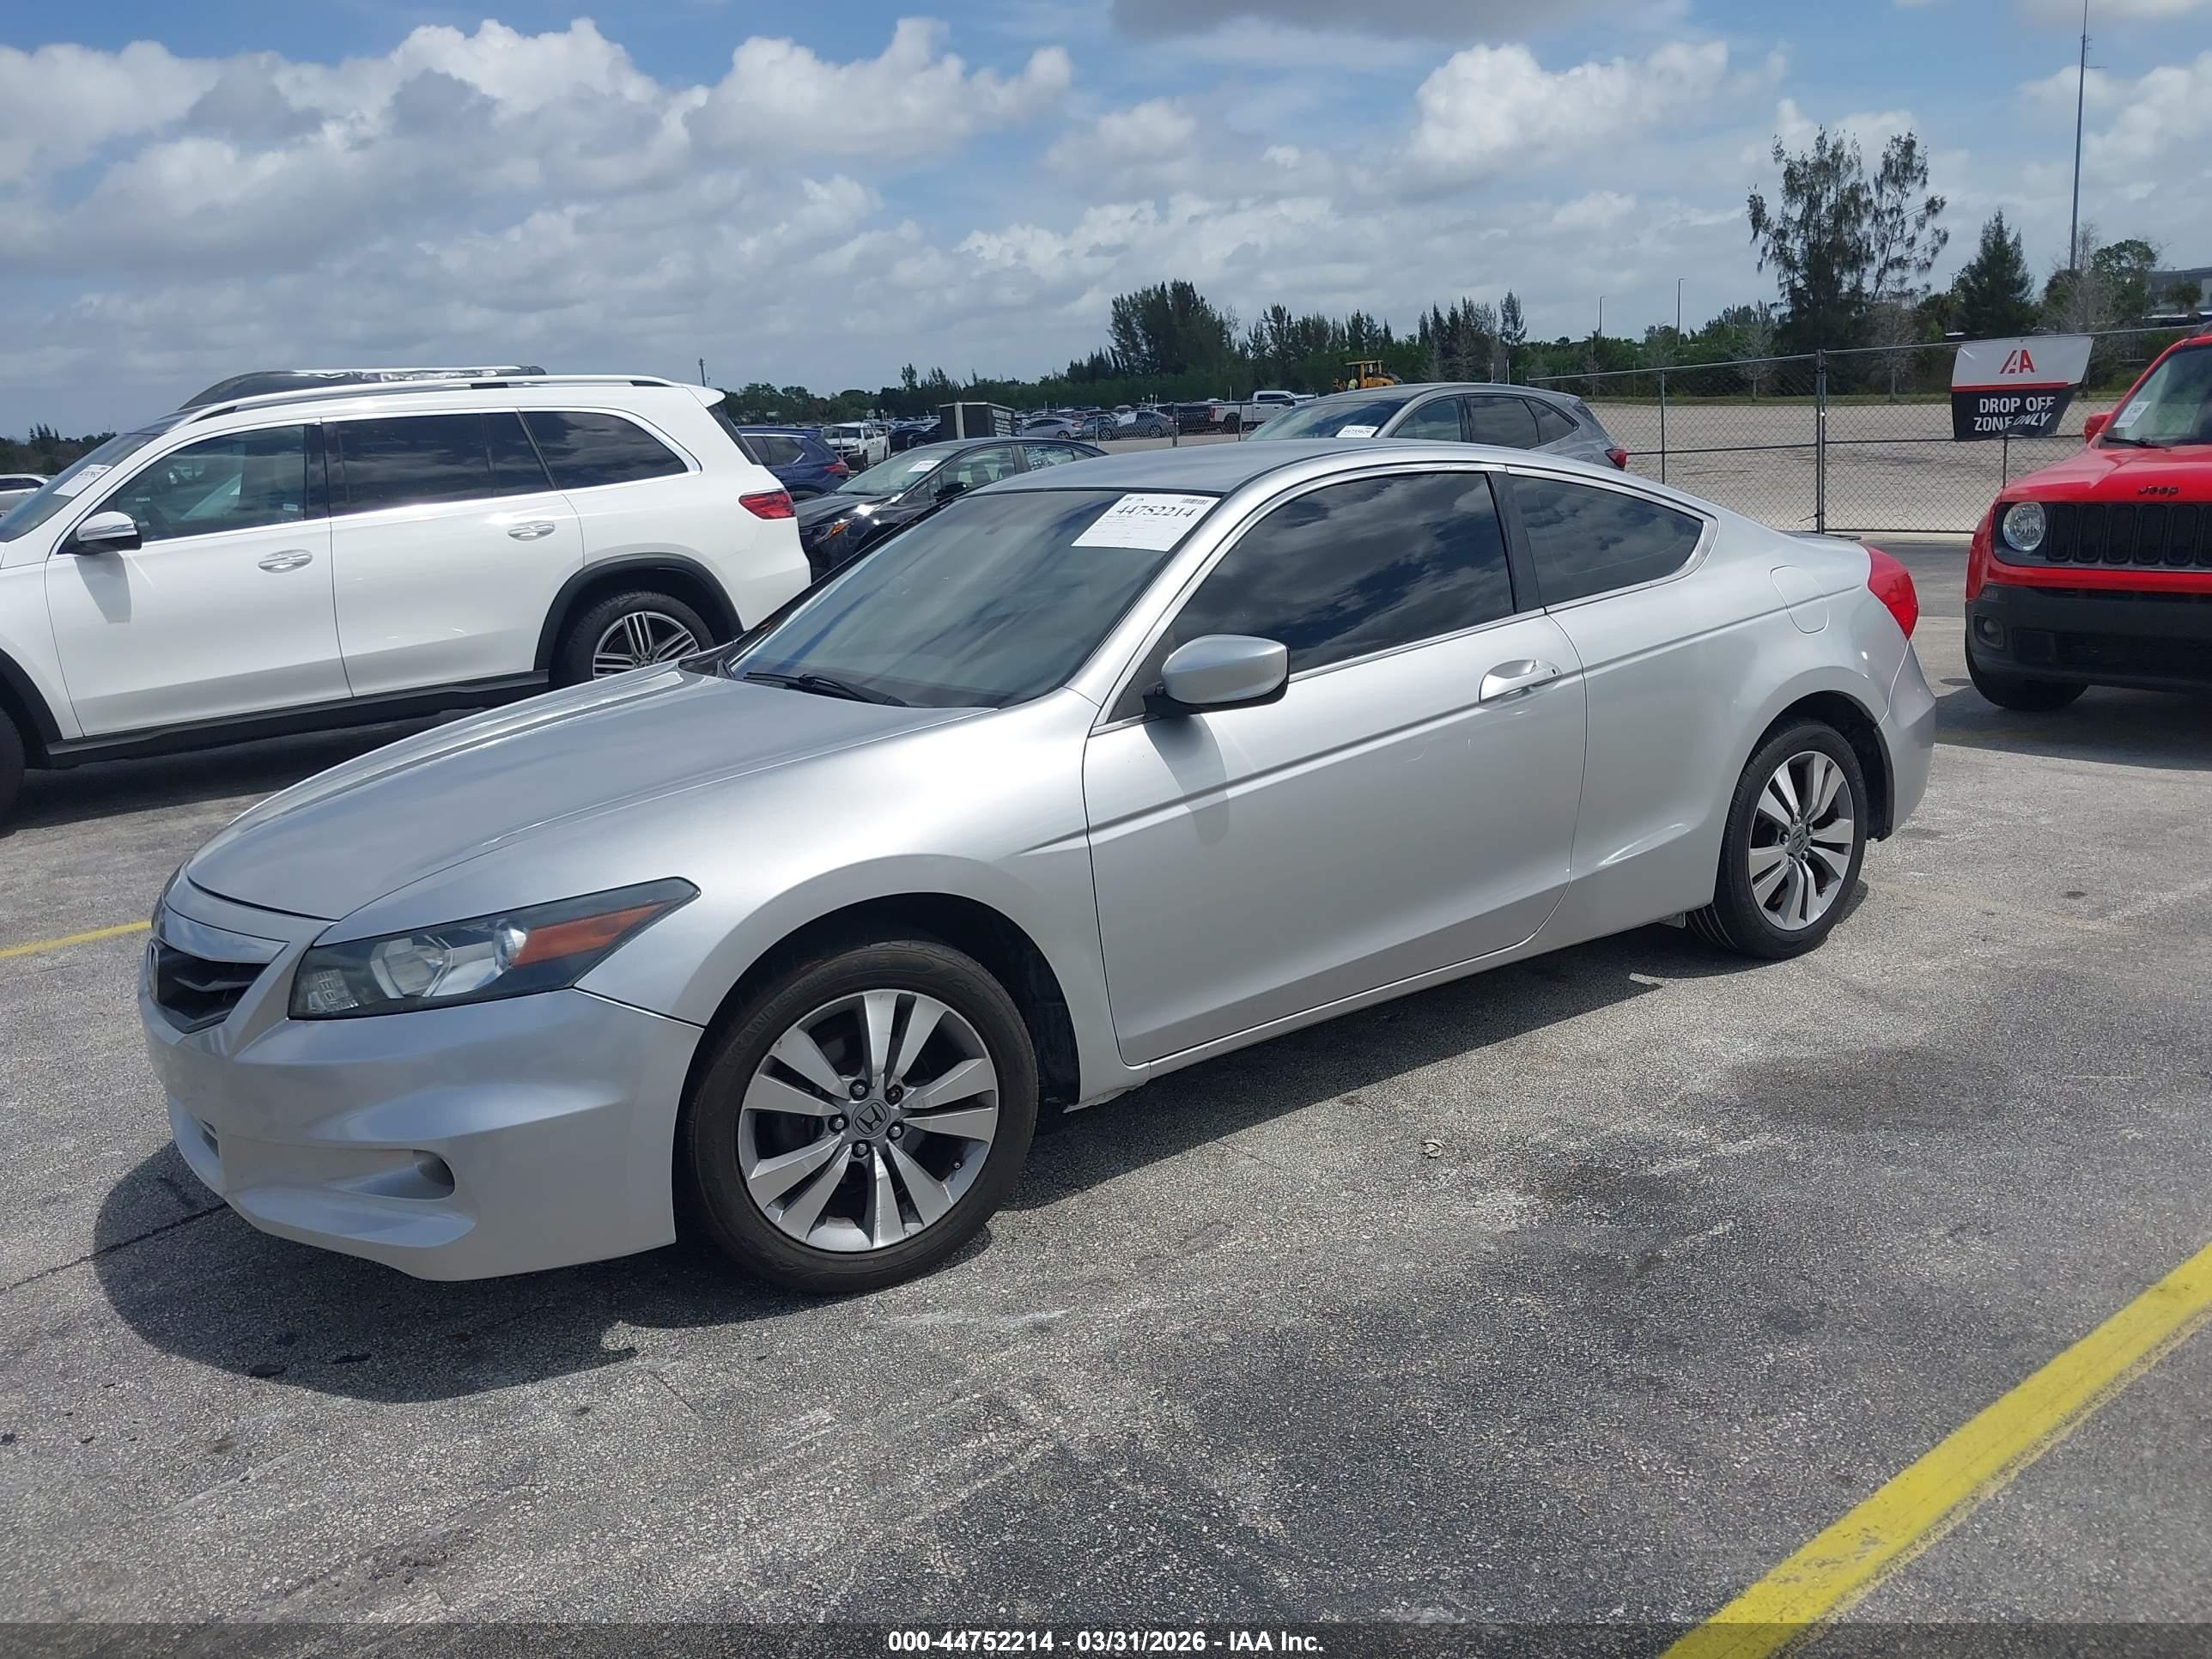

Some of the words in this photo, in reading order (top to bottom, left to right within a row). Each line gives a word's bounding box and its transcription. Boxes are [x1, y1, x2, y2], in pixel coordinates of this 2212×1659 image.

[1979, 398, 2021, 413] DROP
[2026, 396, 2056, 411] OFF
[1973, 416, 2014, 431] ZONE
[2013, 412, 2052, 427] ONLY
[2138, 484, 2179, 496] Jeep
[1115, 505, 1197, 518] 44752214
